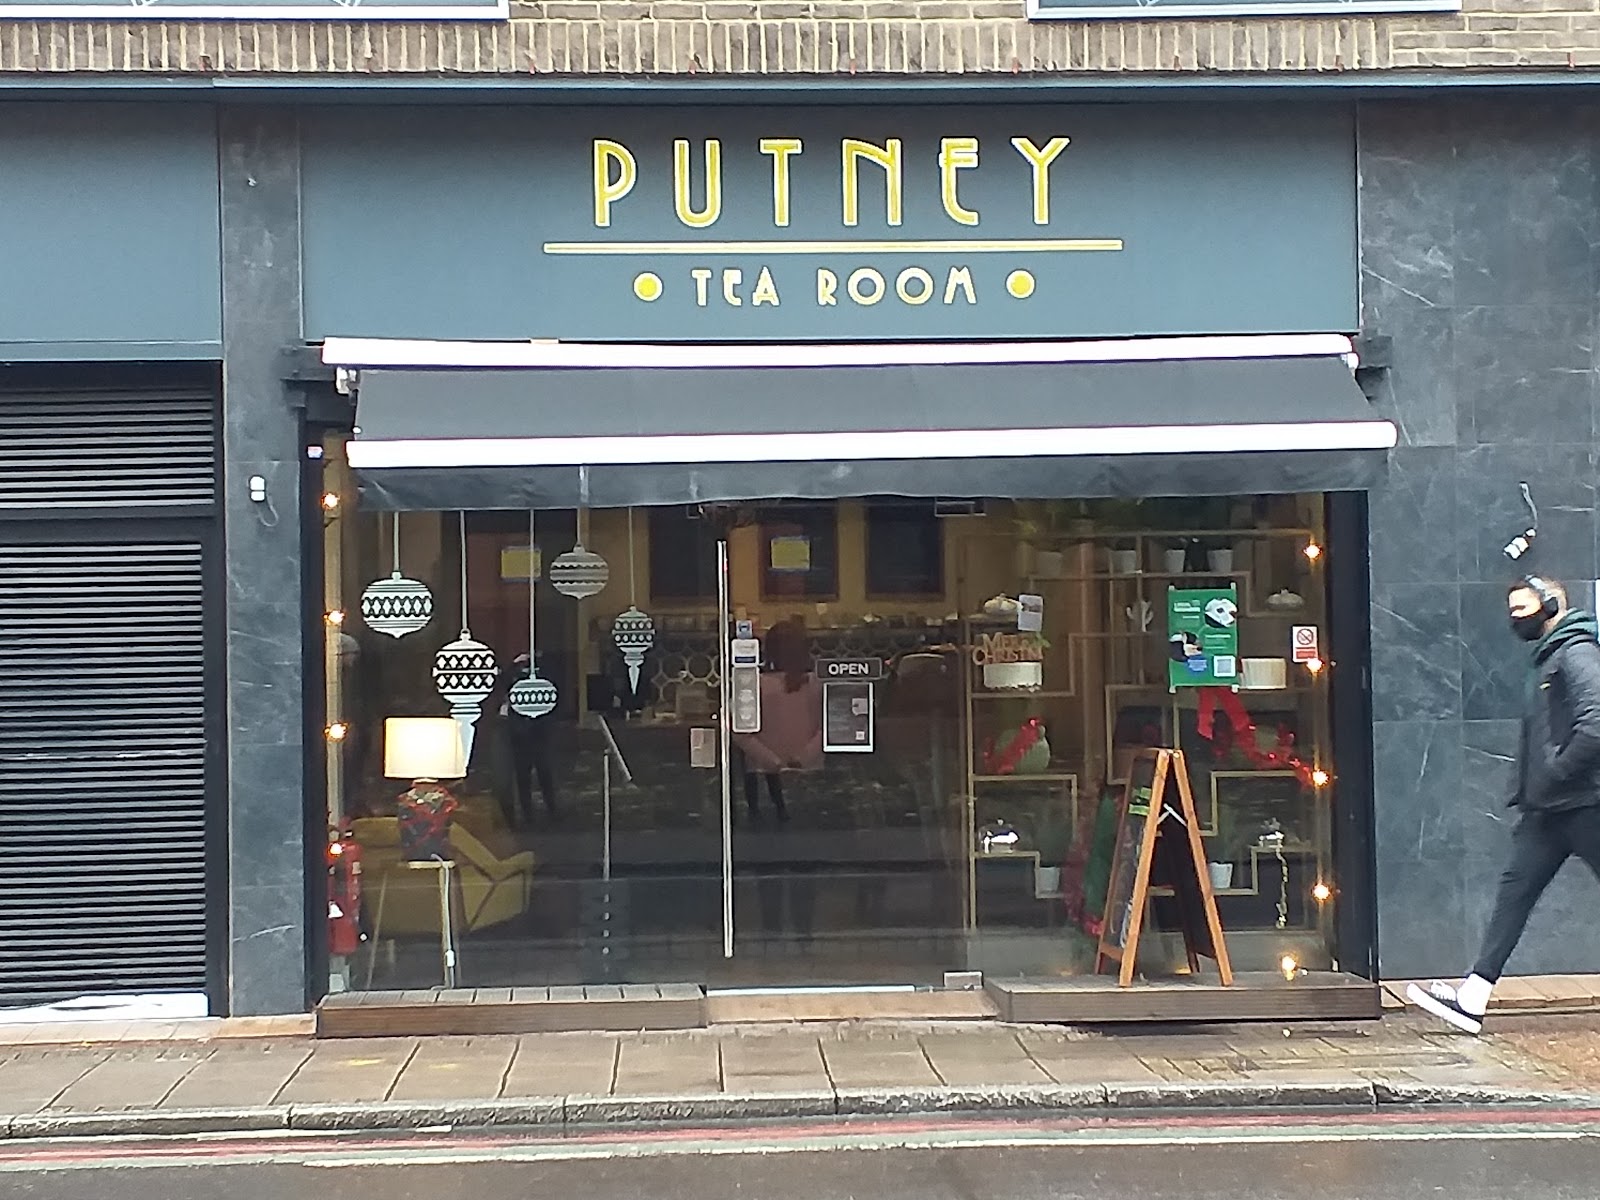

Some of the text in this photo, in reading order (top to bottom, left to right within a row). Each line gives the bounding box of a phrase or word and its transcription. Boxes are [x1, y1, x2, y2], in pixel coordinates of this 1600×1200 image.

[593, 138, 1070, 227] PUTNEY
[691, 266, 977, 306] TEA ROOM
[828, 663, 869, 675] OPEN
